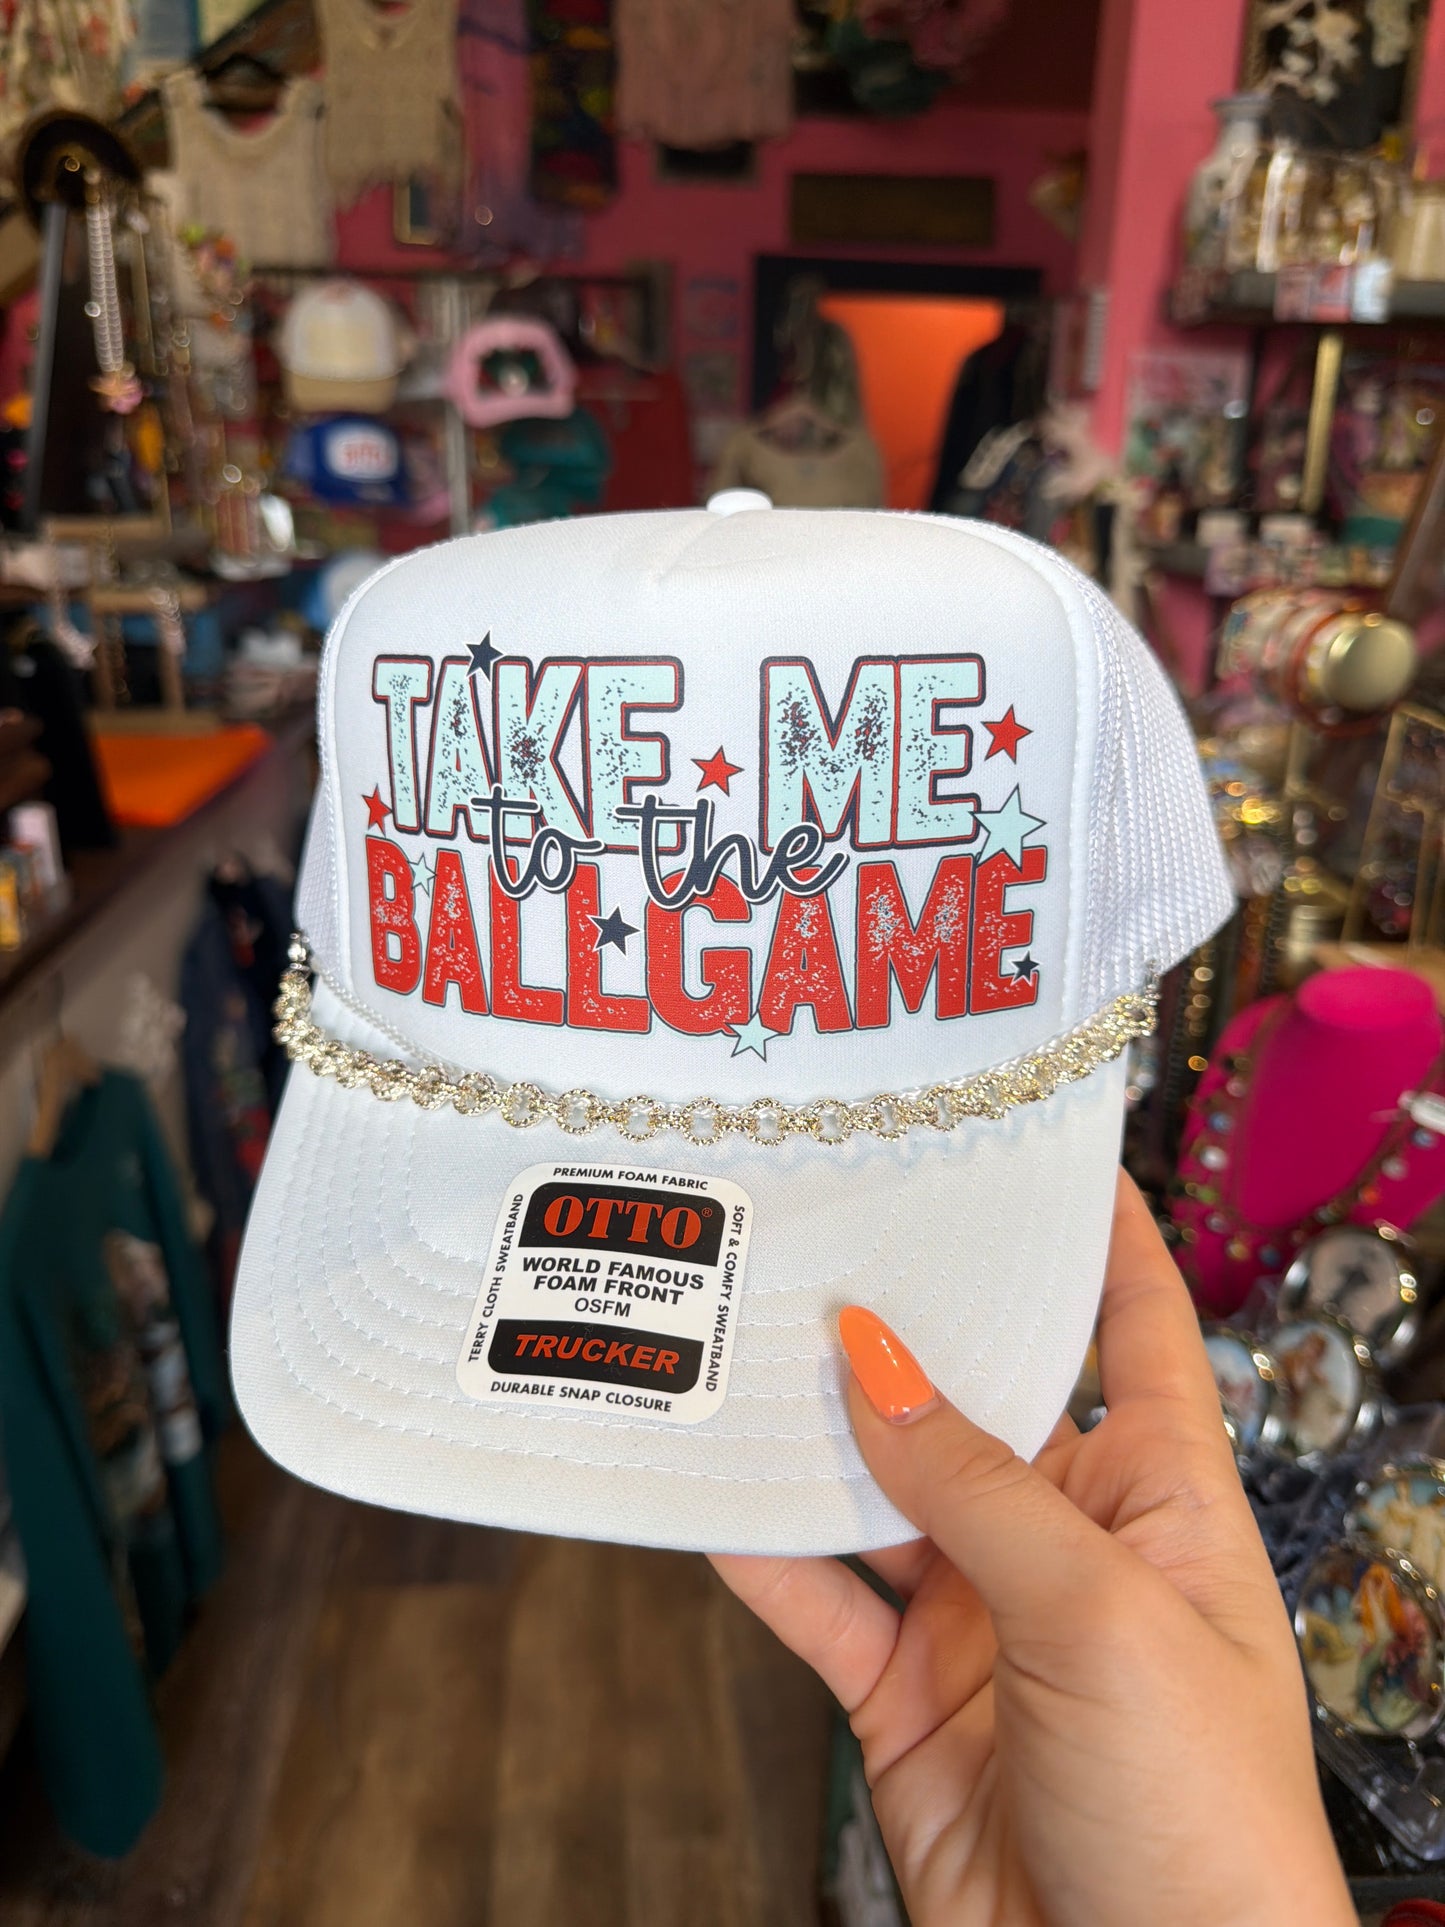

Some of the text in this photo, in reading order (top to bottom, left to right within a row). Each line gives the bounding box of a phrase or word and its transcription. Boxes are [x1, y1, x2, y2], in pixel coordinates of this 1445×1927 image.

[372, 653, 987, 856] TAKE ME
[470, 785, 850, 910] to the
[365, 834, 1048, 1036] BALLGAME
[553, 1167, 708, 1190] PREMIUM FOAM FABRIC
[468, 1193, 524, 1362] TERRY CLOTH SWEATBAND
[523, 1257, 704, 1290] WORLD FAMOUS
[533, 1275, 684, 1305] FOAM FRONT
[574, 1297, 631, 1317] OSFM
[705, 1205, 745, 1392] SOFT & COMFY SWEATBAND
[514, 1334, 680, 1374] TRUCKER
[490, 1381, 672, 1412] DURABLE SNAP CLOSURE
